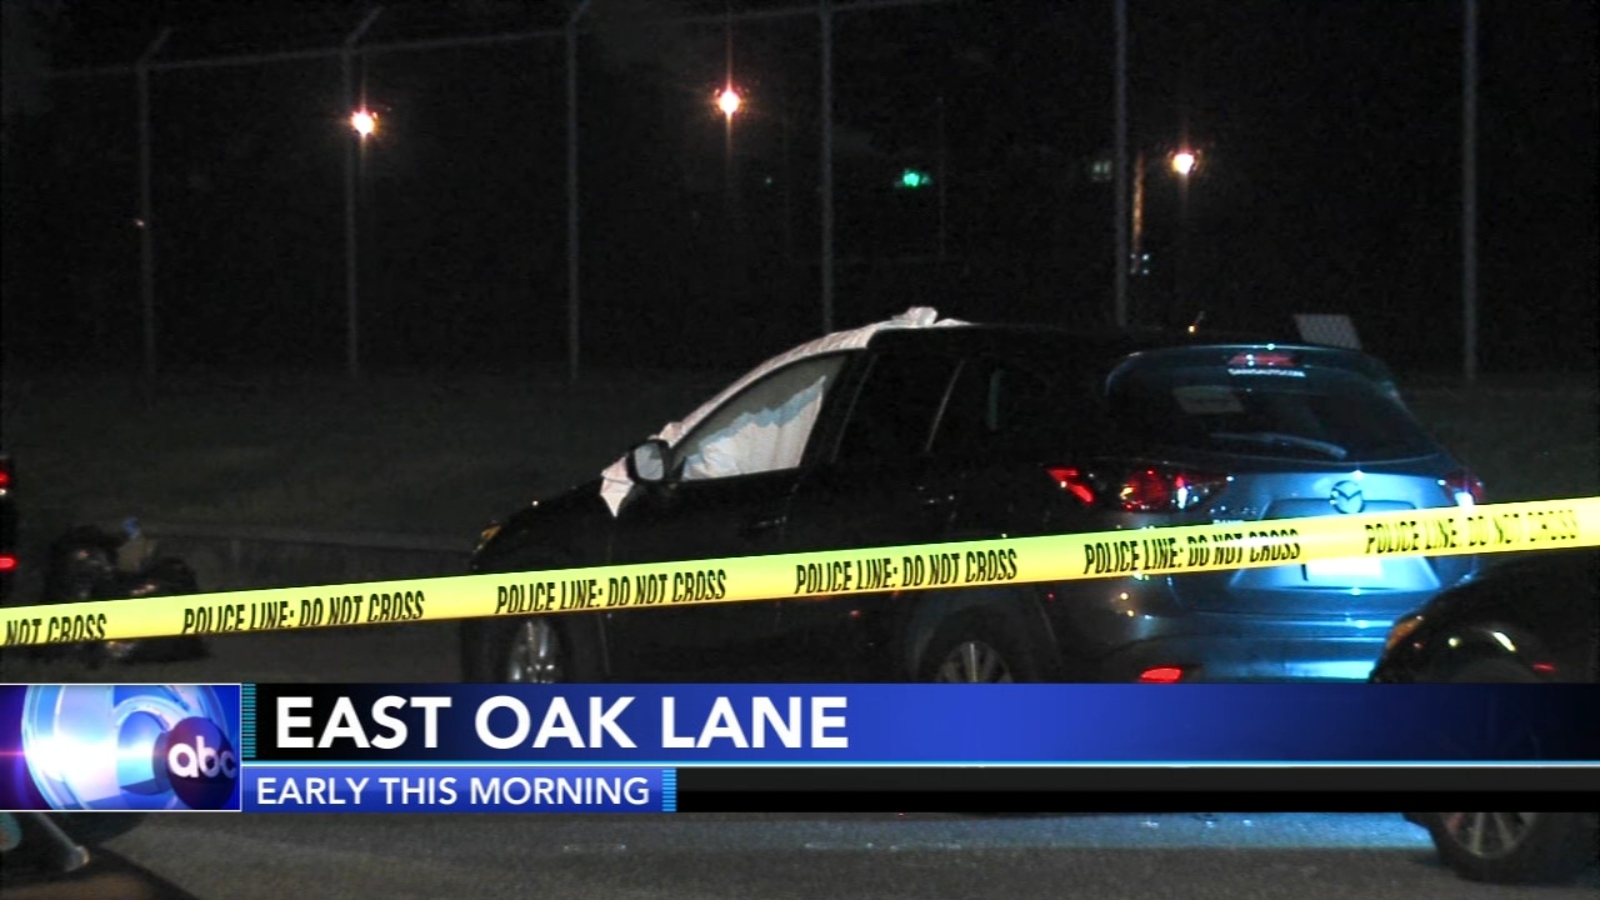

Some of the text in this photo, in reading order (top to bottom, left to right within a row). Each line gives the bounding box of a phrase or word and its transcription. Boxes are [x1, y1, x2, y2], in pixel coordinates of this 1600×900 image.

[1083, 540, 1139, 574] POLICE
[1143, 537, 1184, 570] LINE:
[1187, 535, 1210, 566] DO
[1365, 521, 1419, 553] POLICE
[1424, 518, 1461, 549] LINE
[495, 569, 727, 614] POLICE LINE: DO NOT CROSS
[794, 548, 1017, 594] POLICE LINE: DO NOT CROSS
[4, 613, 107, 646] NOT CROSS
[182, 590, 425, 634] POLICE LINE: DO NOT CROSS
